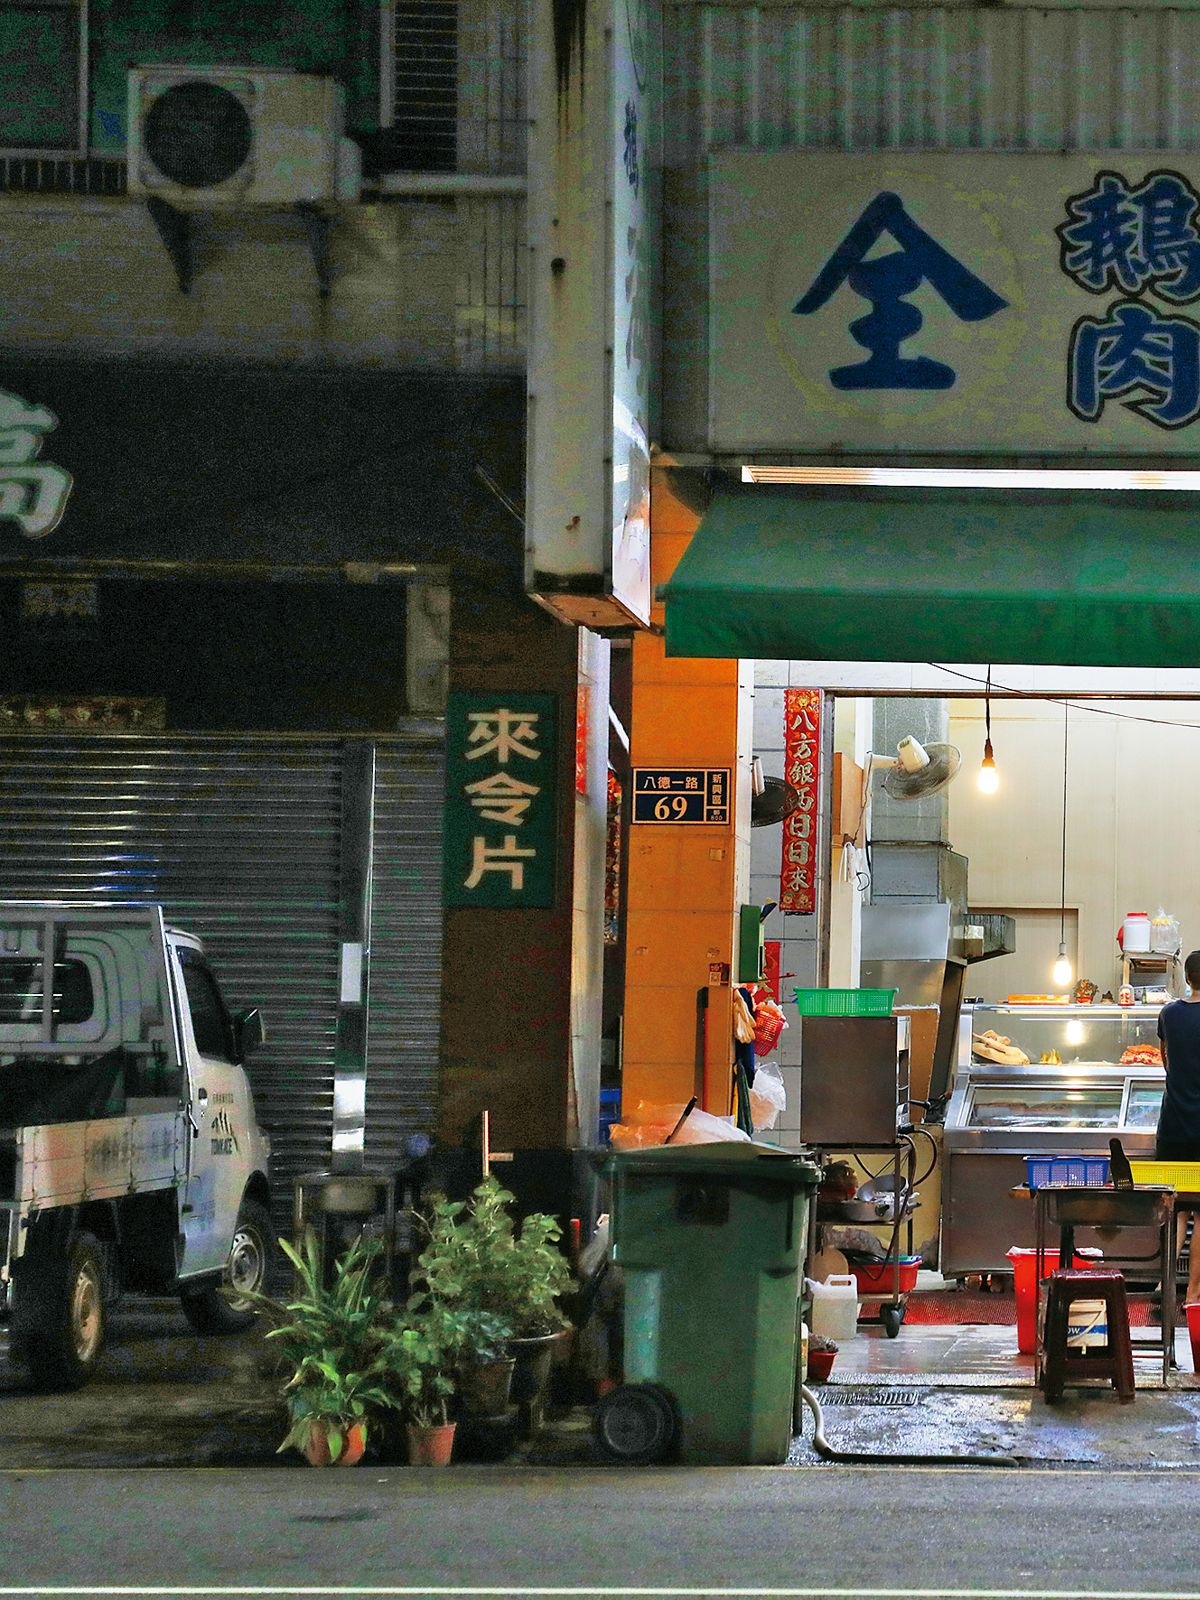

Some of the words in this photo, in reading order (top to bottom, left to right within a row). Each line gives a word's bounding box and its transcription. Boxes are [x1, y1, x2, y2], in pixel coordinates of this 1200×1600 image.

[791, 190, 1010, 392] 全
[463, 708, 541, 891] 來令片
[643, 776, 699, 790] 八德一路
[654, 796, 688, 821] 69
